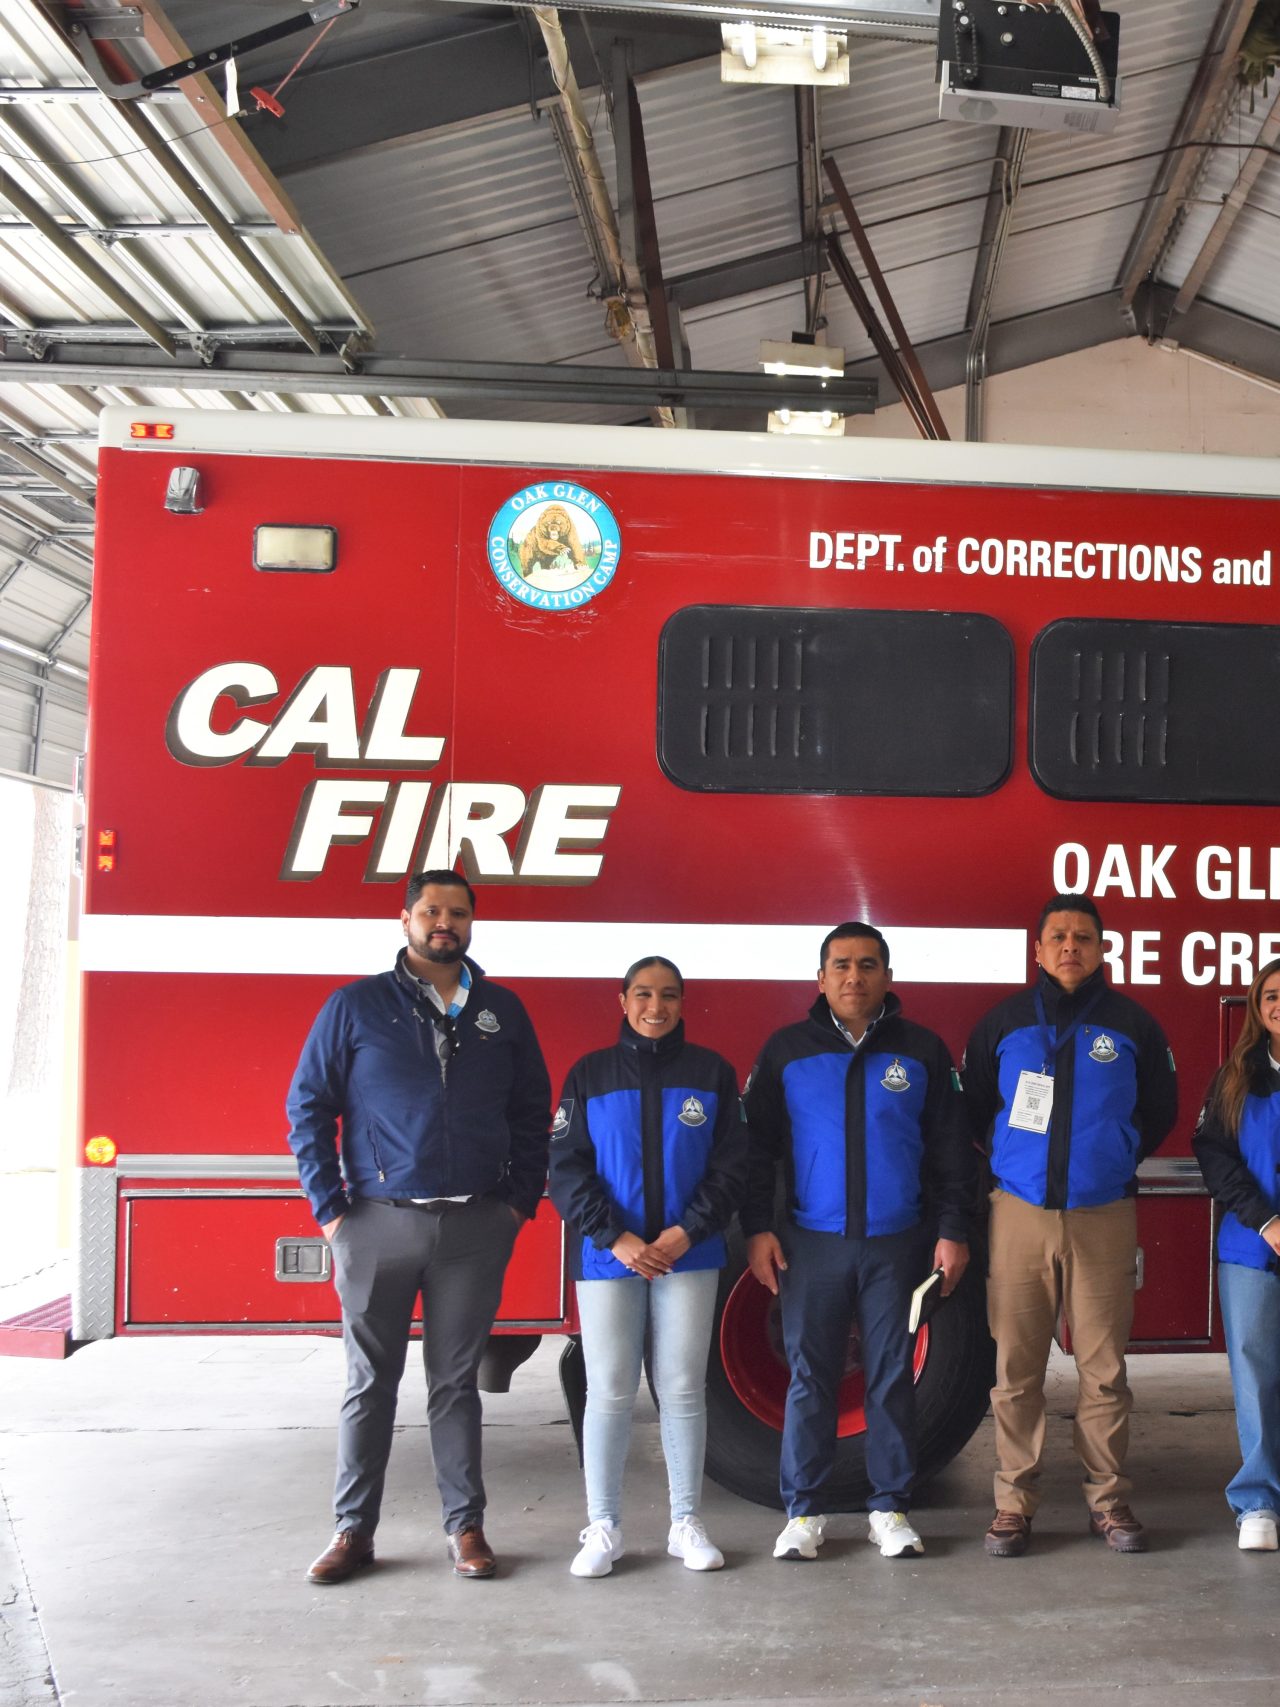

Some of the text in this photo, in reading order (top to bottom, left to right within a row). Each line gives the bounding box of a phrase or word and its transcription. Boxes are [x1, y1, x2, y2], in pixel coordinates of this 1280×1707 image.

[511, 484, 601, 513] OAK GLEN
[491, 536, 618, 607] CONSERVATION CAMP
[809, 531, 905, 572] DEPT.
[912, 536, 947, 573] of
[957, 537, 1202, 584] CORRECTIONS
[1212, 550, 1271, 586] and
[165, 661, 447, 770] CAL
[279, 779, 623, 886] FIRE
[1053, 842, 1177, 899] OAK
